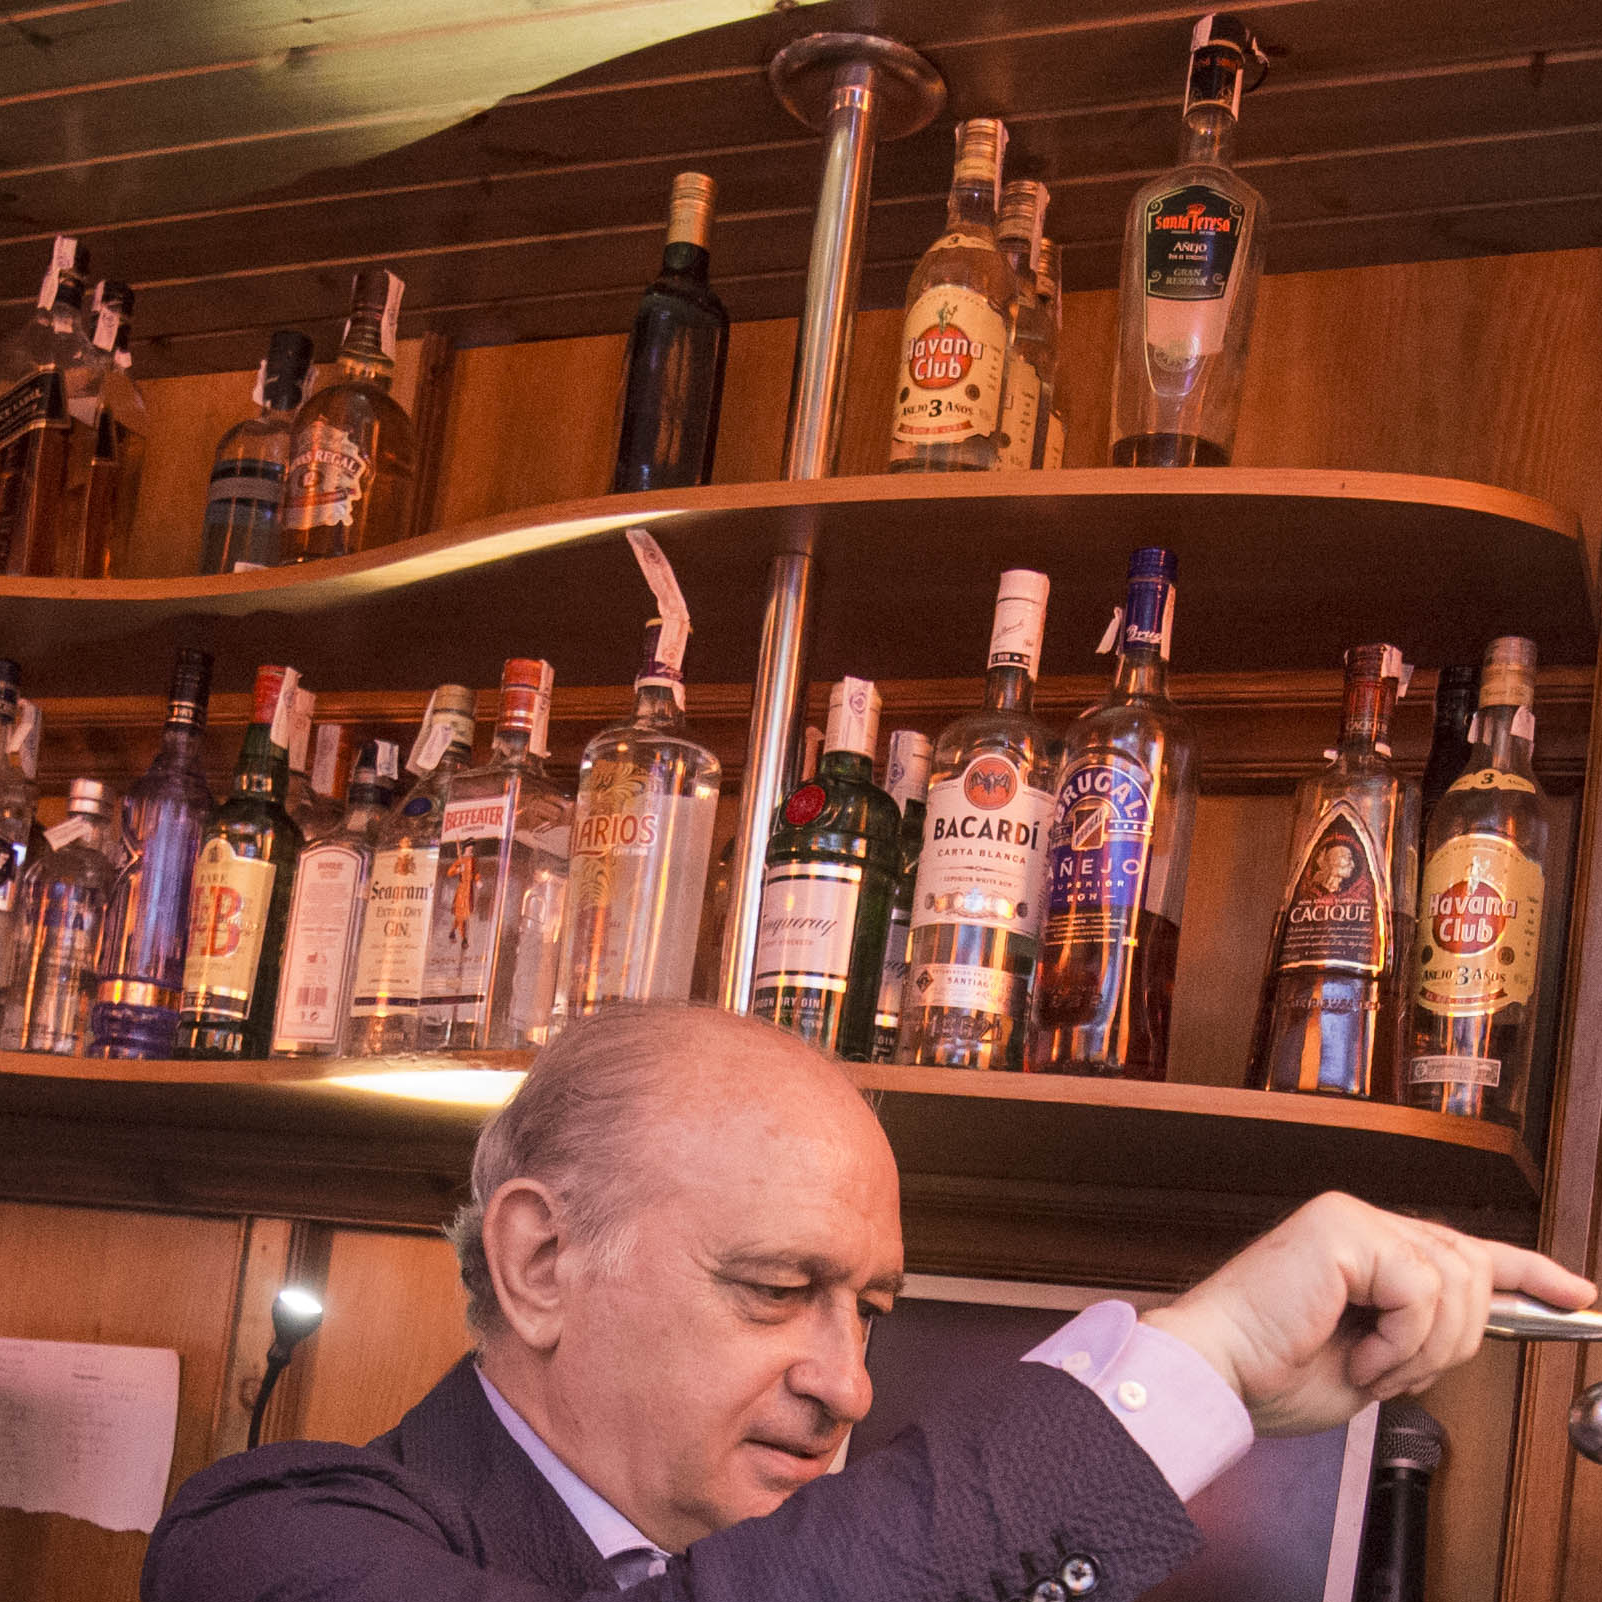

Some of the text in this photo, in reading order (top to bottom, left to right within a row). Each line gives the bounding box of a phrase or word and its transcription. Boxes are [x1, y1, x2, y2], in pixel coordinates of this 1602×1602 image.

[904, 336, 983, 361] Havana
[914, 356, 962, 381] Club
[929, 399, 943, 417] 3
[315, 450, 358, 473] REGAL
[1481, 773, 1494, 784] 3
[444, 806, 504, 832] BEEFEATER
[933, 815, 1040, 850] BACARDÍ
[938, 849, 1026, 865] CARTA BLANCA
[371, 881, 434, 904] Seagram'
[1290, 903, 1372, 923] CACIQUE
[1429, 893, 1518, 920] Havana
[383, 920, 409, 937] GIN
[1439, 917, 1493, 943] Club
[1454, 965, 1470, 985] 3
